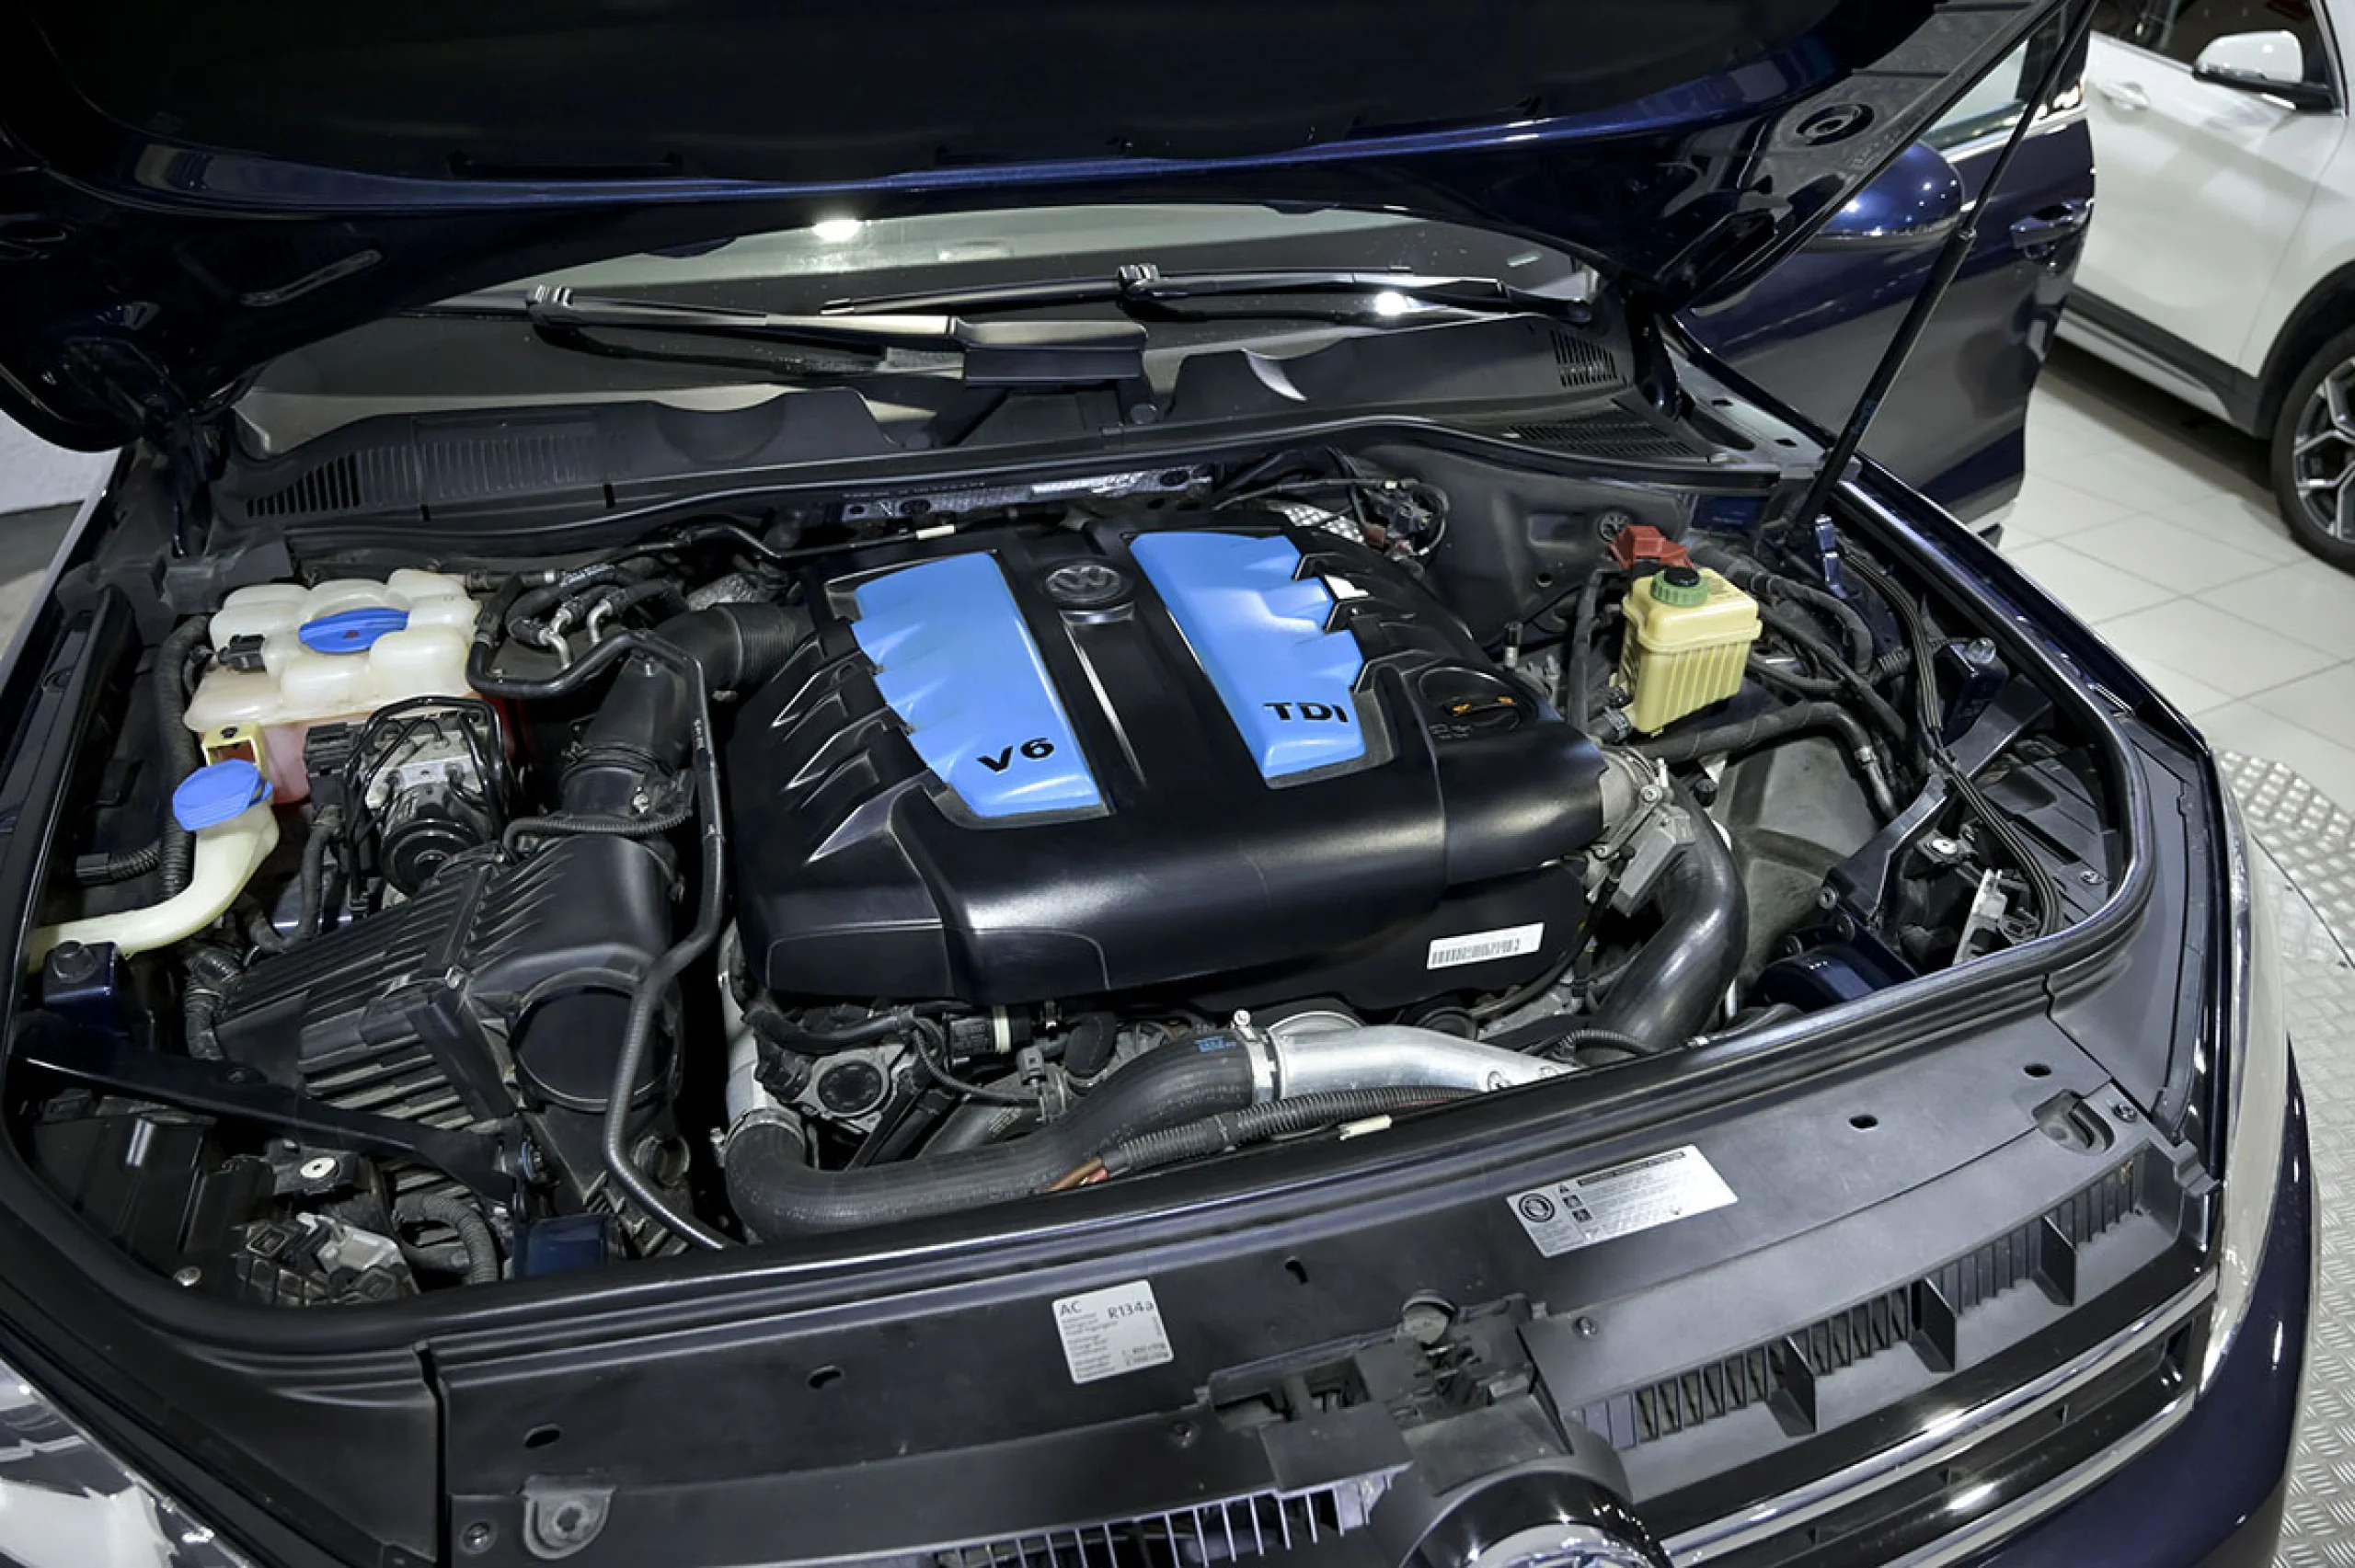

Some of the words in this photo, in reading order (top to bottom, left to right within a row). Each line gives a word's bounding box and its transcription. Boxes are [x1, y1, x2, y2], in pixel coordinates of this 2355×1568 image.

[1263, 702, 1349, 723] TDI
[976, 737, 1055, 773] V6
[1060, 1300, 1082, 1316] AC
[1107, 1300, 1155, 1319] R134a
